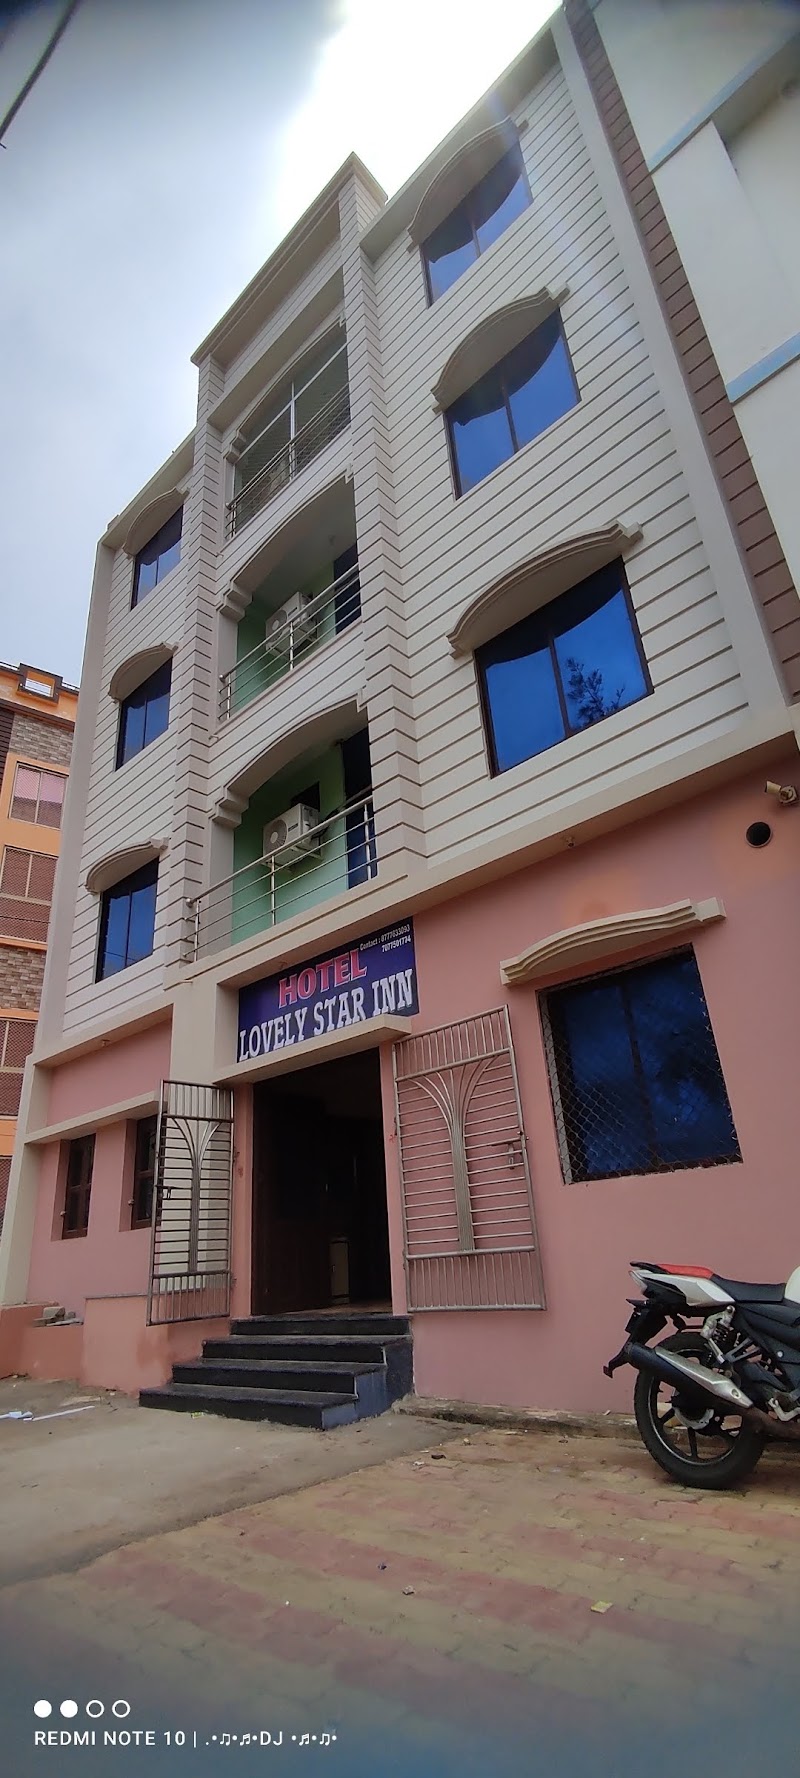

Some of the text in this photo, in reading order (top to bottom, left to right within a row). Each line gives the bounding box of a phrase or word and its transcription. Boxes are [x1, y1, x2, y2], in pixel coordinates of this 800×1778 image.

[360, 938, 378, 951] Contact
[278, 948, 368, 1008] HOTEL
[239, 969, 412, 1062] LOVELY STAR INN
